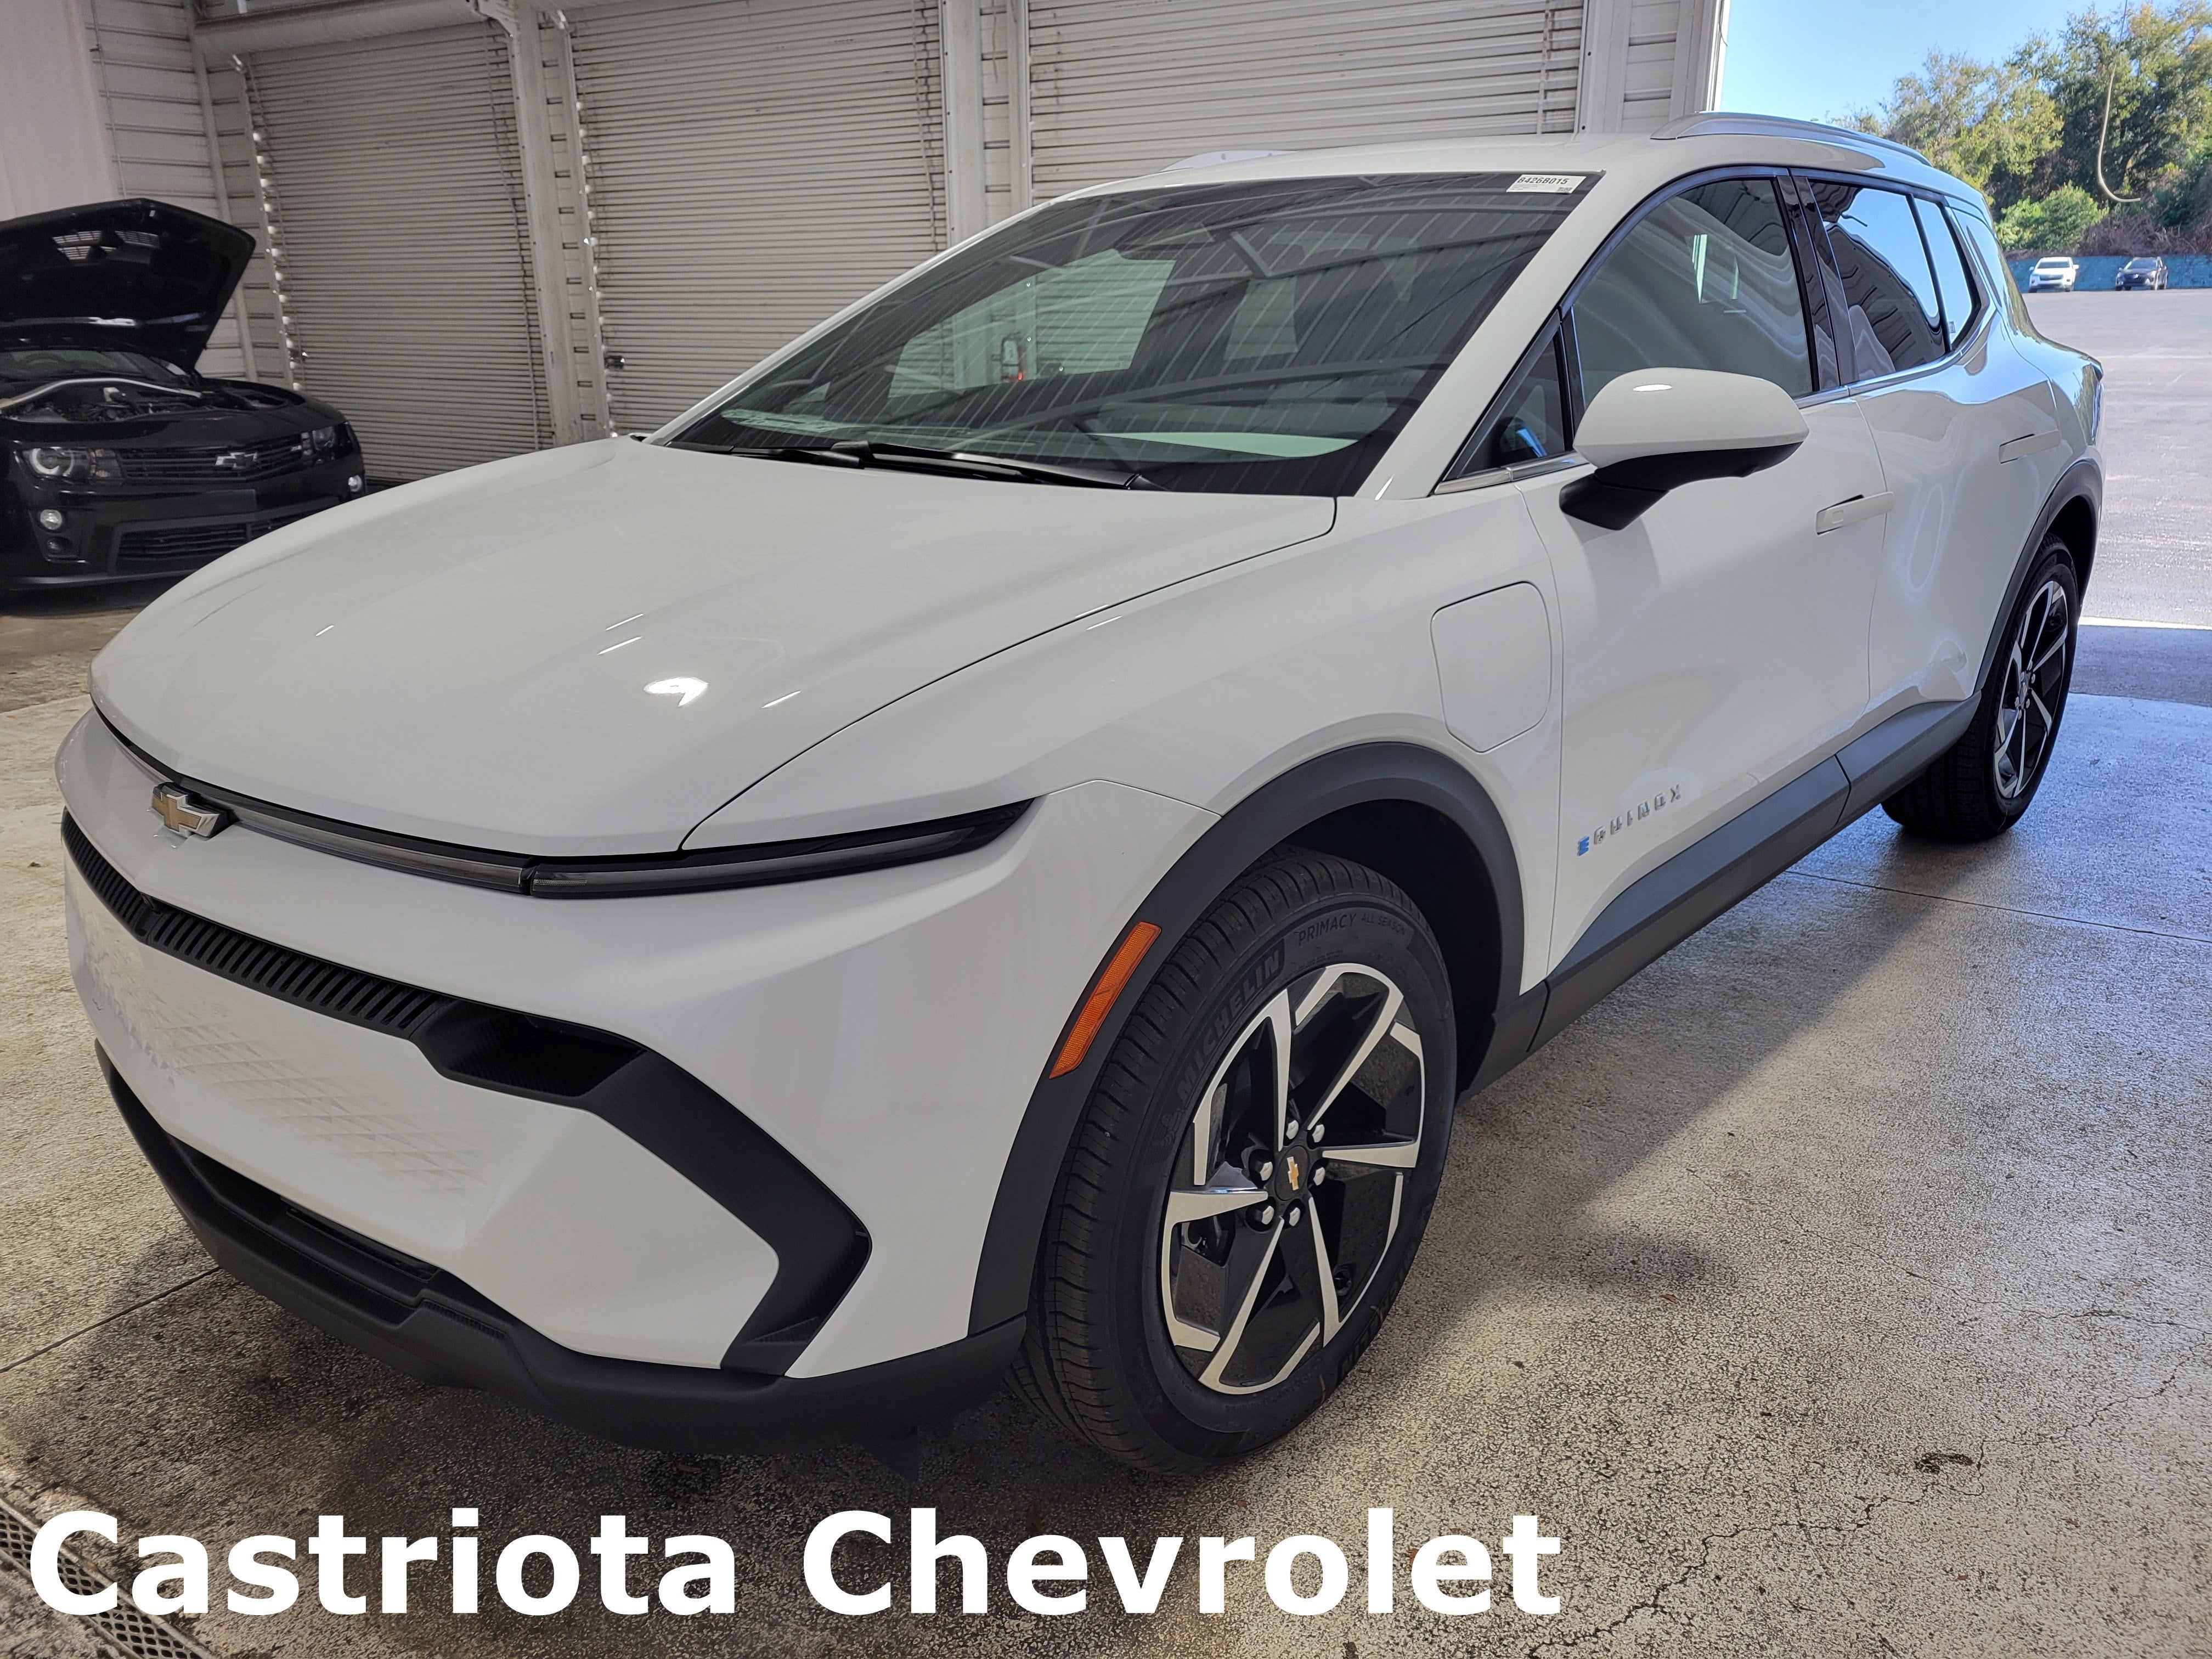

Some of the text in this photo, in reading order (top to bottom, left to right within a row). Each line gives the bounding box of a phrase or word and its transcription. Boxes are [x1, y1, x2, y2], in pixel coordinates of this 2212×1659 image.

[1577, 783, 1681, 856] EQUINOX
[1298, 913, 1356, 946] PRIMACY
[1177, 950, 1280, 1104] MICHELIN
